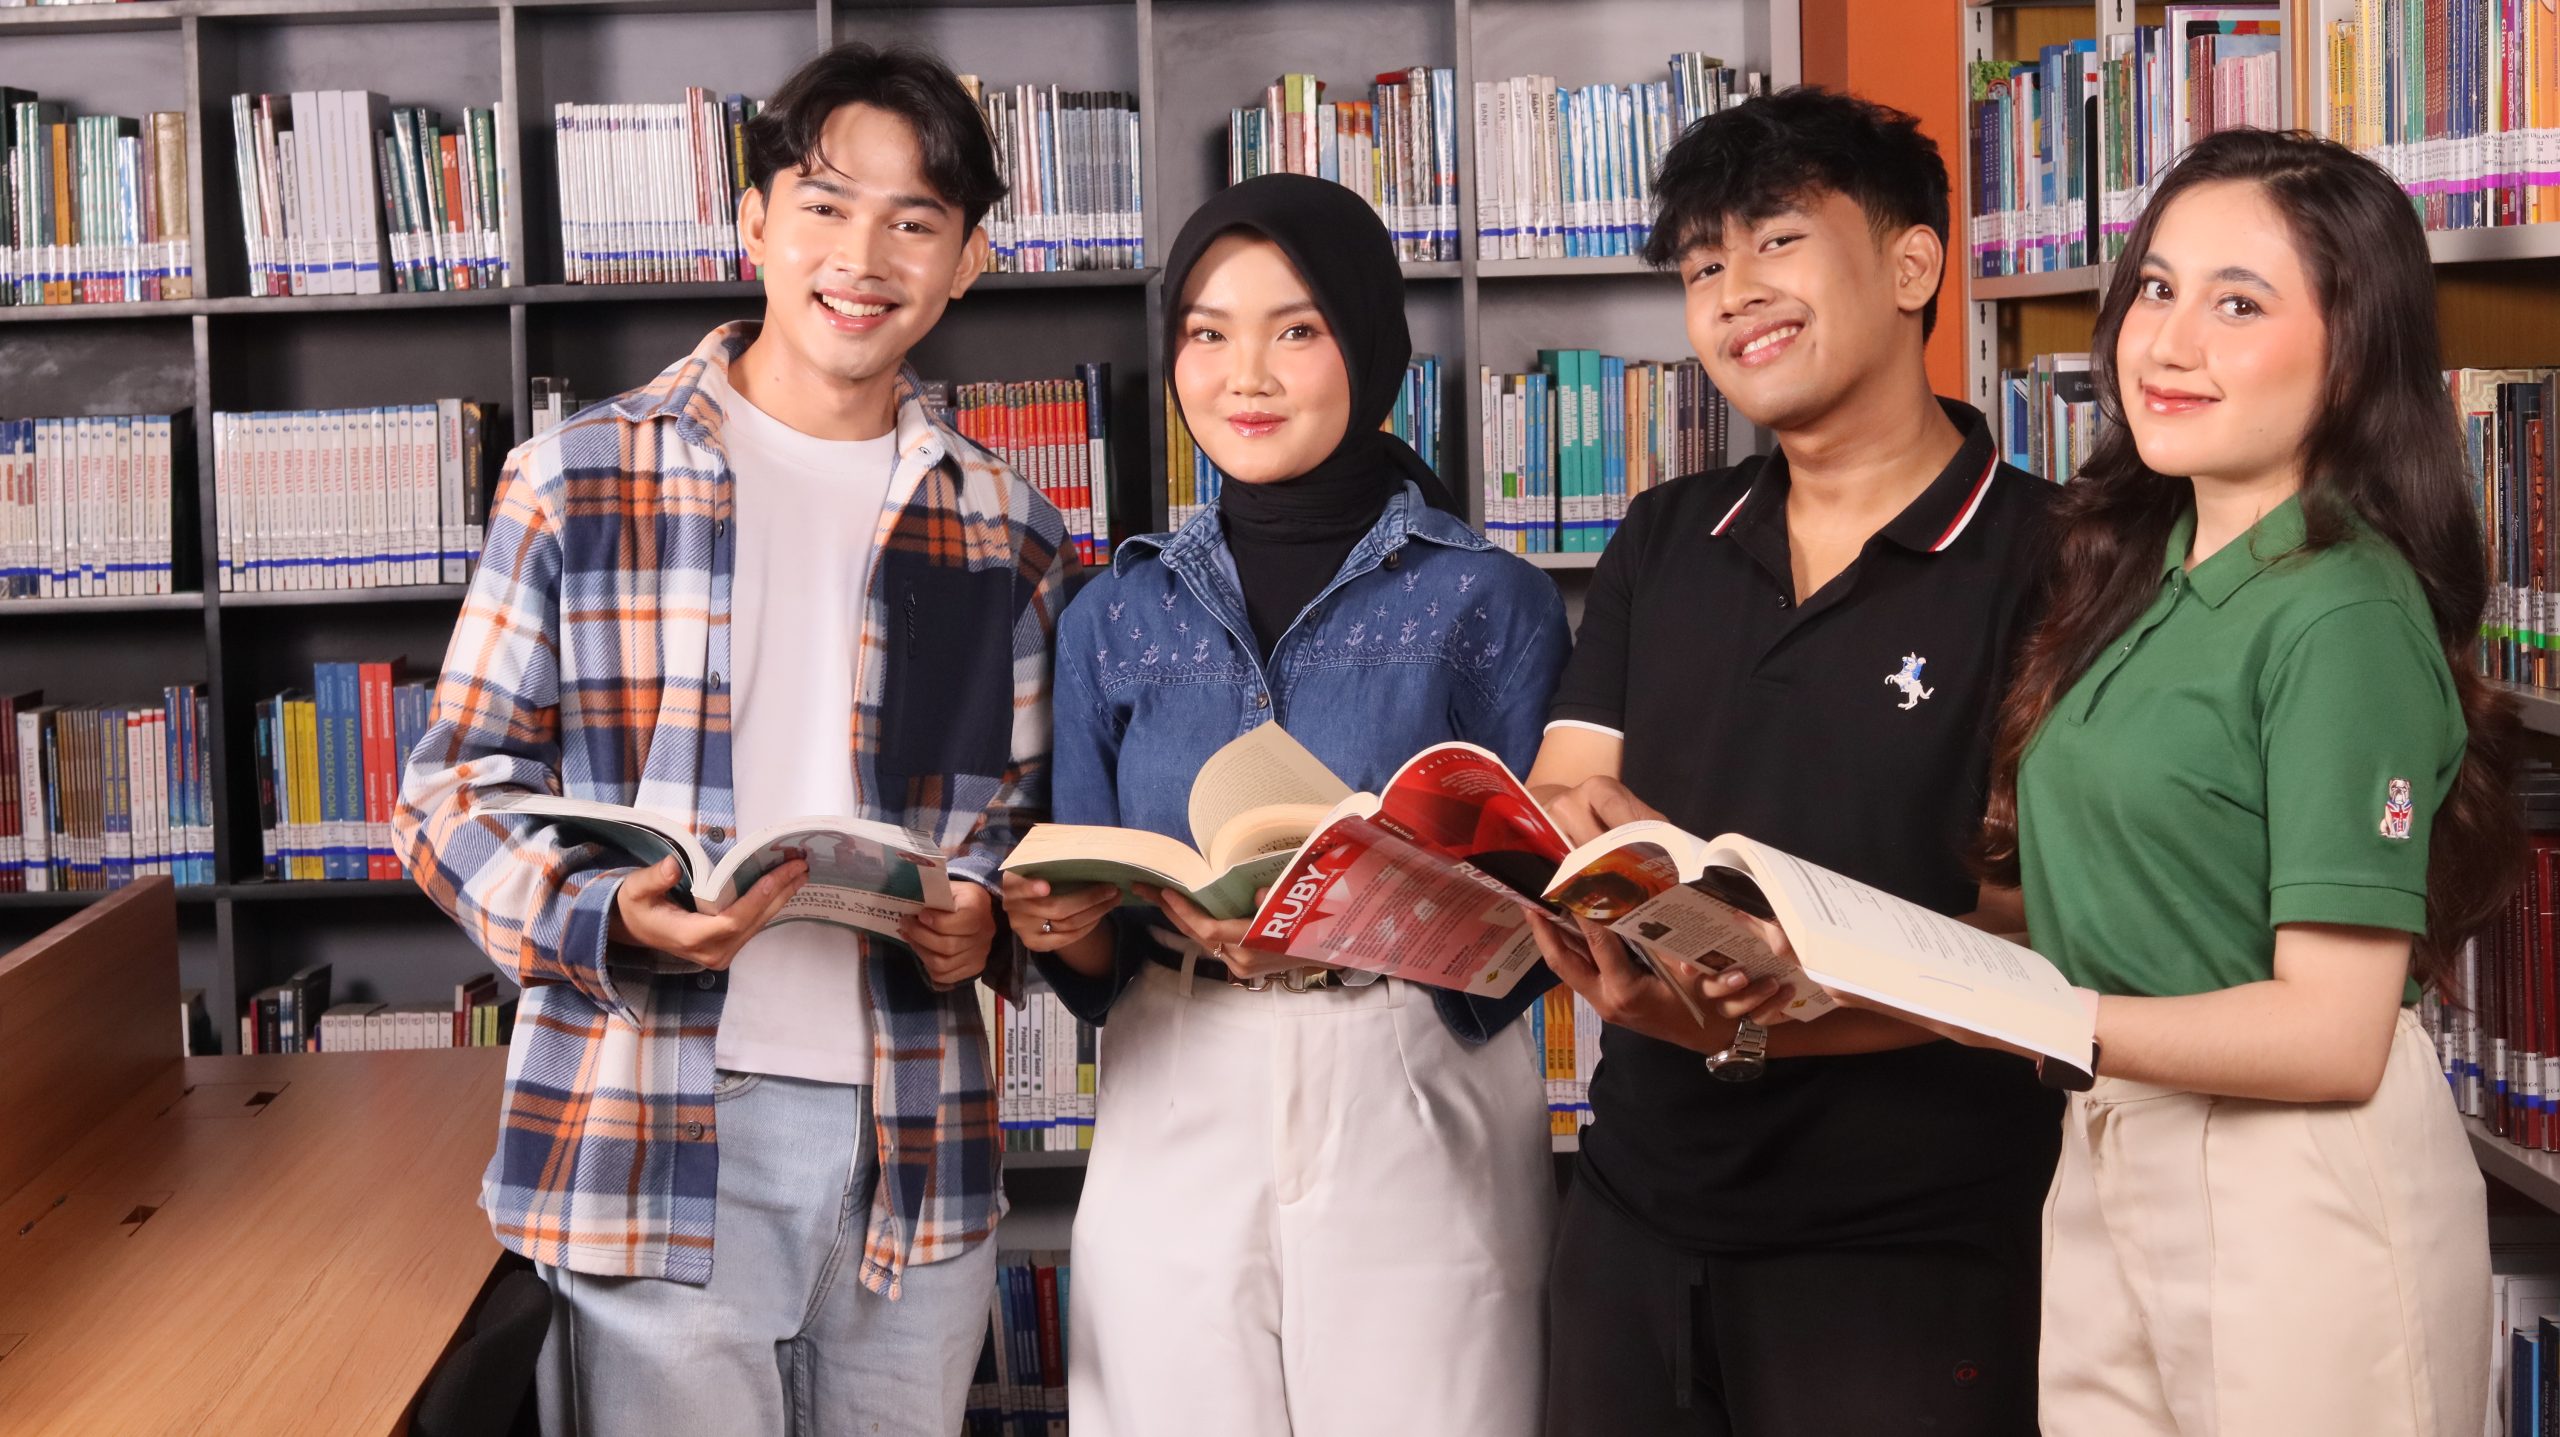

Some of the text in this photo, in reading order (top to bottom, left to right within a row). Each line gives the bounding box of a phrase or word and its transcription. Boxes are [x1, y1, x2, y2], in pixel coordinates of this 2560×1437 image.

[1038, 446, 1047, 489] KEWIRAUSAHAAN
[1048, 445, 1057, 488] KEWIRAUSAHAAN
[1059, 445, 1068, 487] KEWIRAUSAHAAN
[1069, 444, 1078, 487] KEWIRAUSAHAAN
[1079, 444, 1088, 487] KEWIRAUSAHAAN
[364, 681, 373, 738] Makroekonomi
[381, 681, 391, 738] Makroekonomi
[323, 718, 335, 817] MAKROEKONOMI
[345, 718, 357, 817] MAKROEKONOMI
[29, 790, 37, 817] ADAT
[1452, 861, 1519, 894] RUBY
[1261, 864, 1328, 939] RUBY
[1006, 1029, 1014, 1055] Patologi
[1033, 1029, 1041, 1056] Patologi
